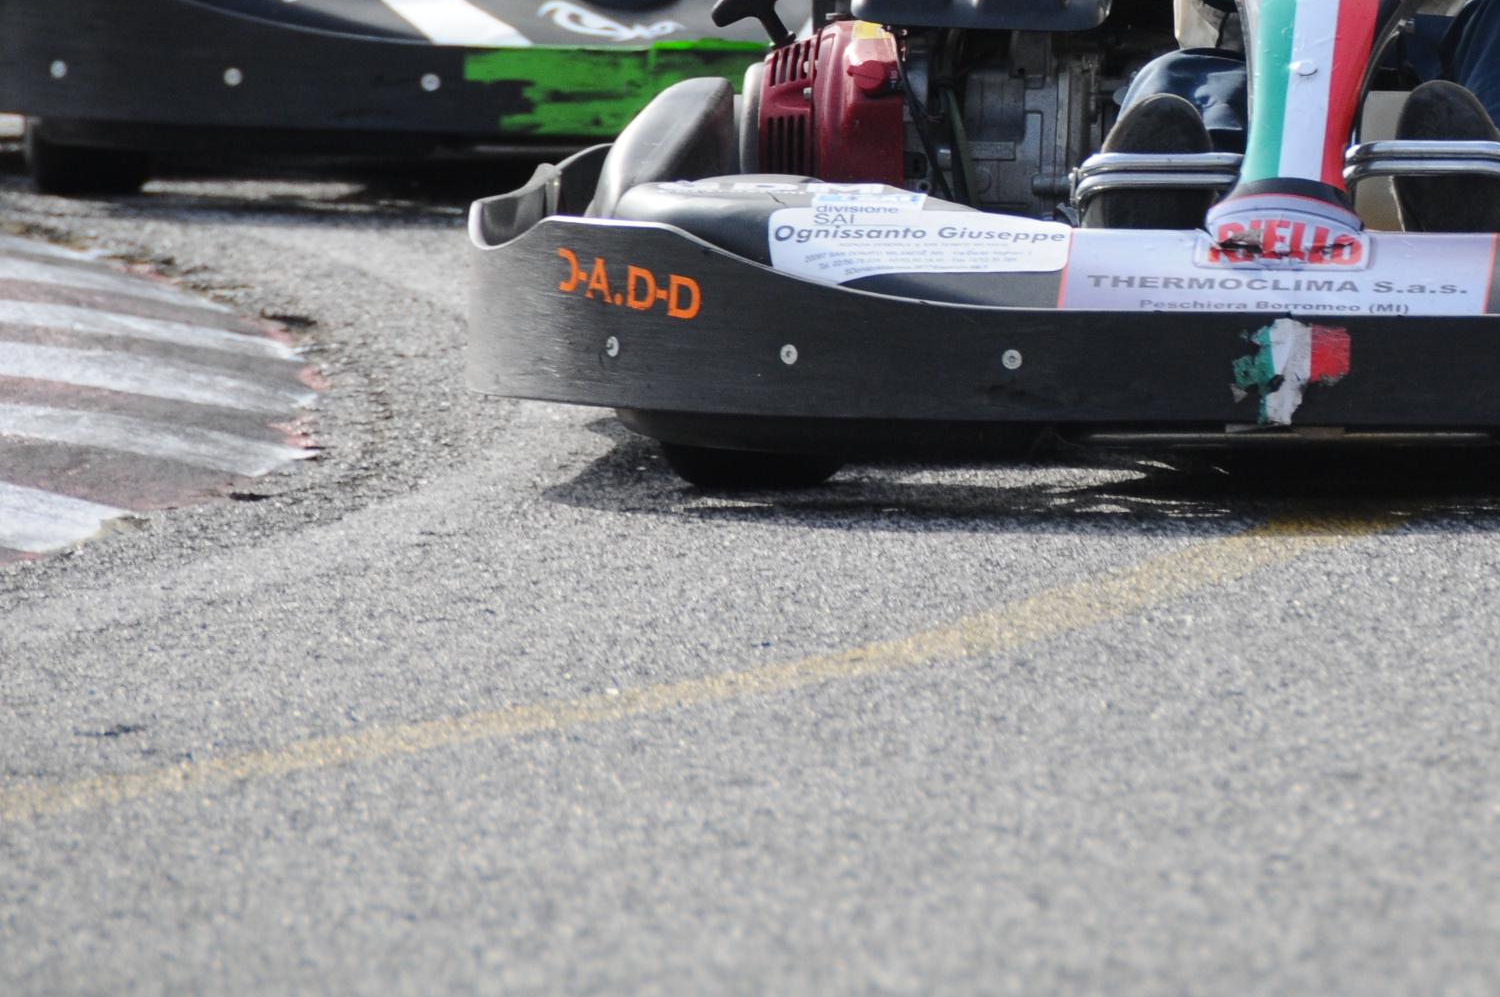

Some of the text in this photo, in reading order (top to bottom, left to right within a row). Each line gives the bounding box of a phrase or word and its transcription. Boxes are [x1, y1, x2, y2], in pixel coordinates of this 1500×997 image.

[816, 205, 899, 214] divisione
[814, 213, 854, 224] SAI
[774, 225, 1066, 243] Ognissanto Giuseppe
[1087, 274, 1468, 294] THERMOCLIMA S.a.s.
[1139, 299, 1248, 310] Peschiera
[1254, 300, 1361, 312] Borromeo
